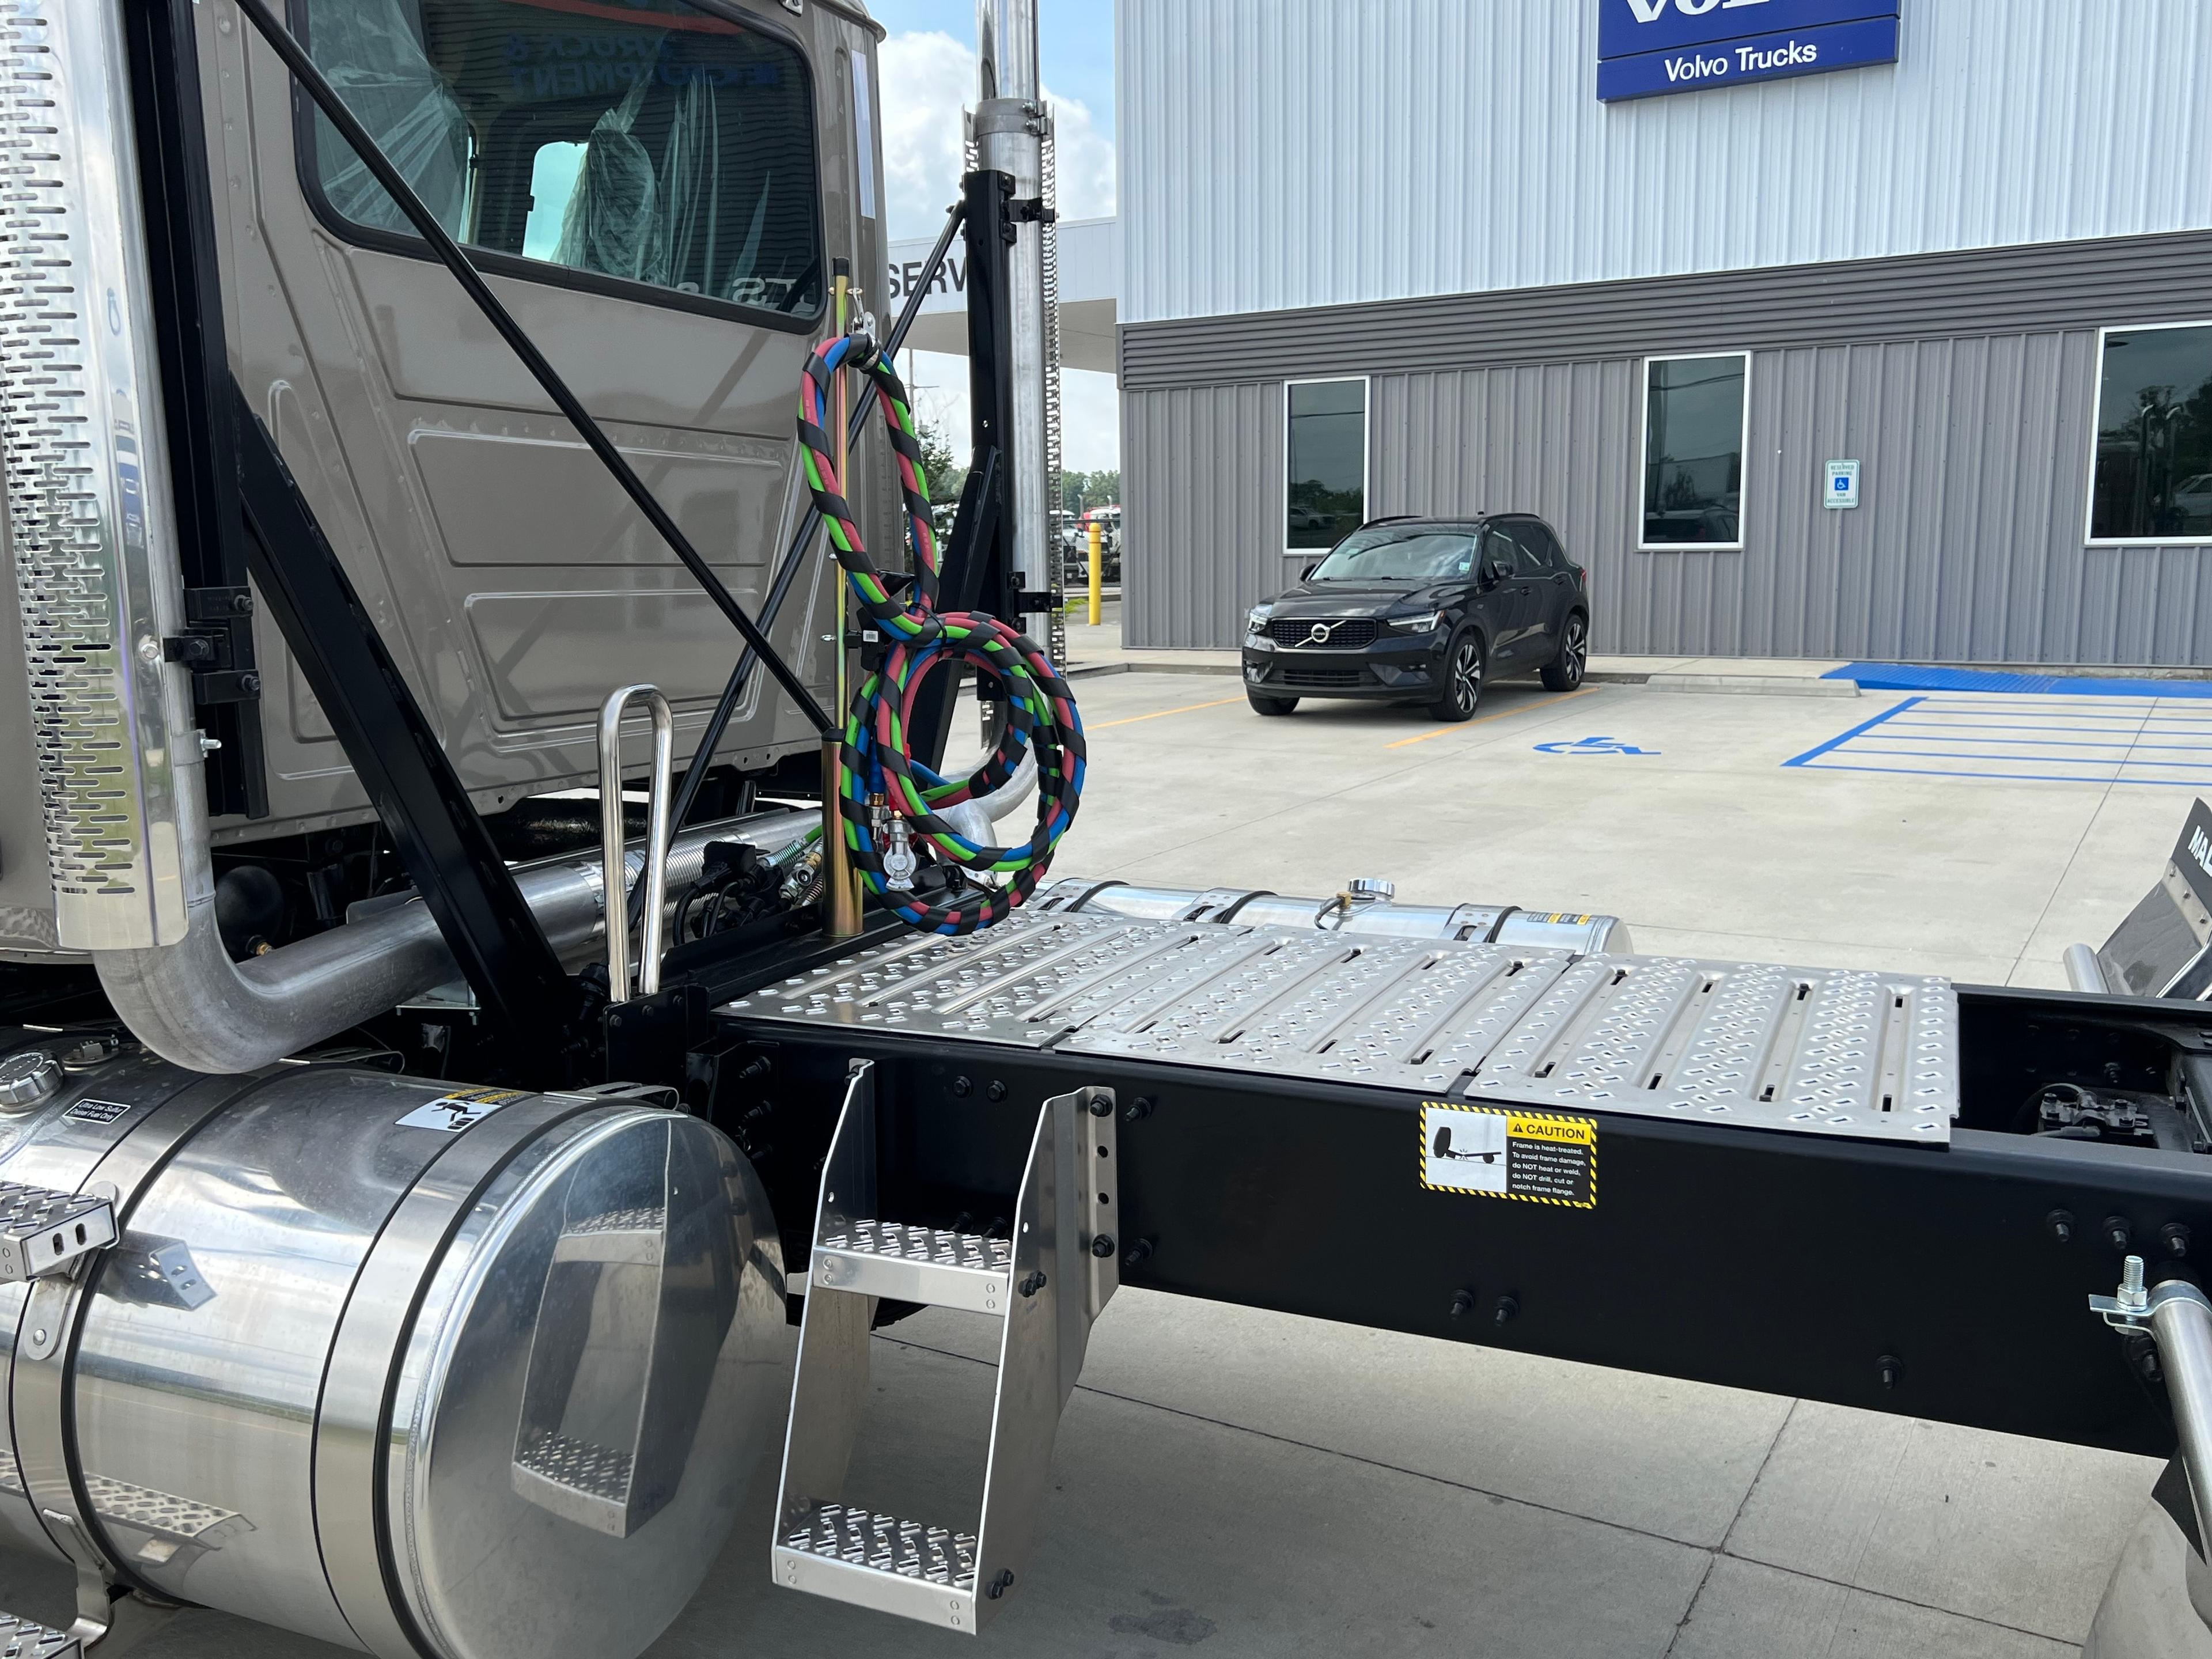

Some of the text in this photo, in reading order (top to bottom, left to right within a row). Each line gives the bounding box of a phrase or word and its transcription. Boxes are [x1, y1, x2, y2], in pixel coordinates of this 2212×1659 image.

[1664, 40, 1817, 82] Volvo Trucks
[1527, 1124, 1585, 1139] CAUTION
[1541, 1145, 1584, 1155] heat-treated.
[1552, 1187, 1574, 1196] flange.
